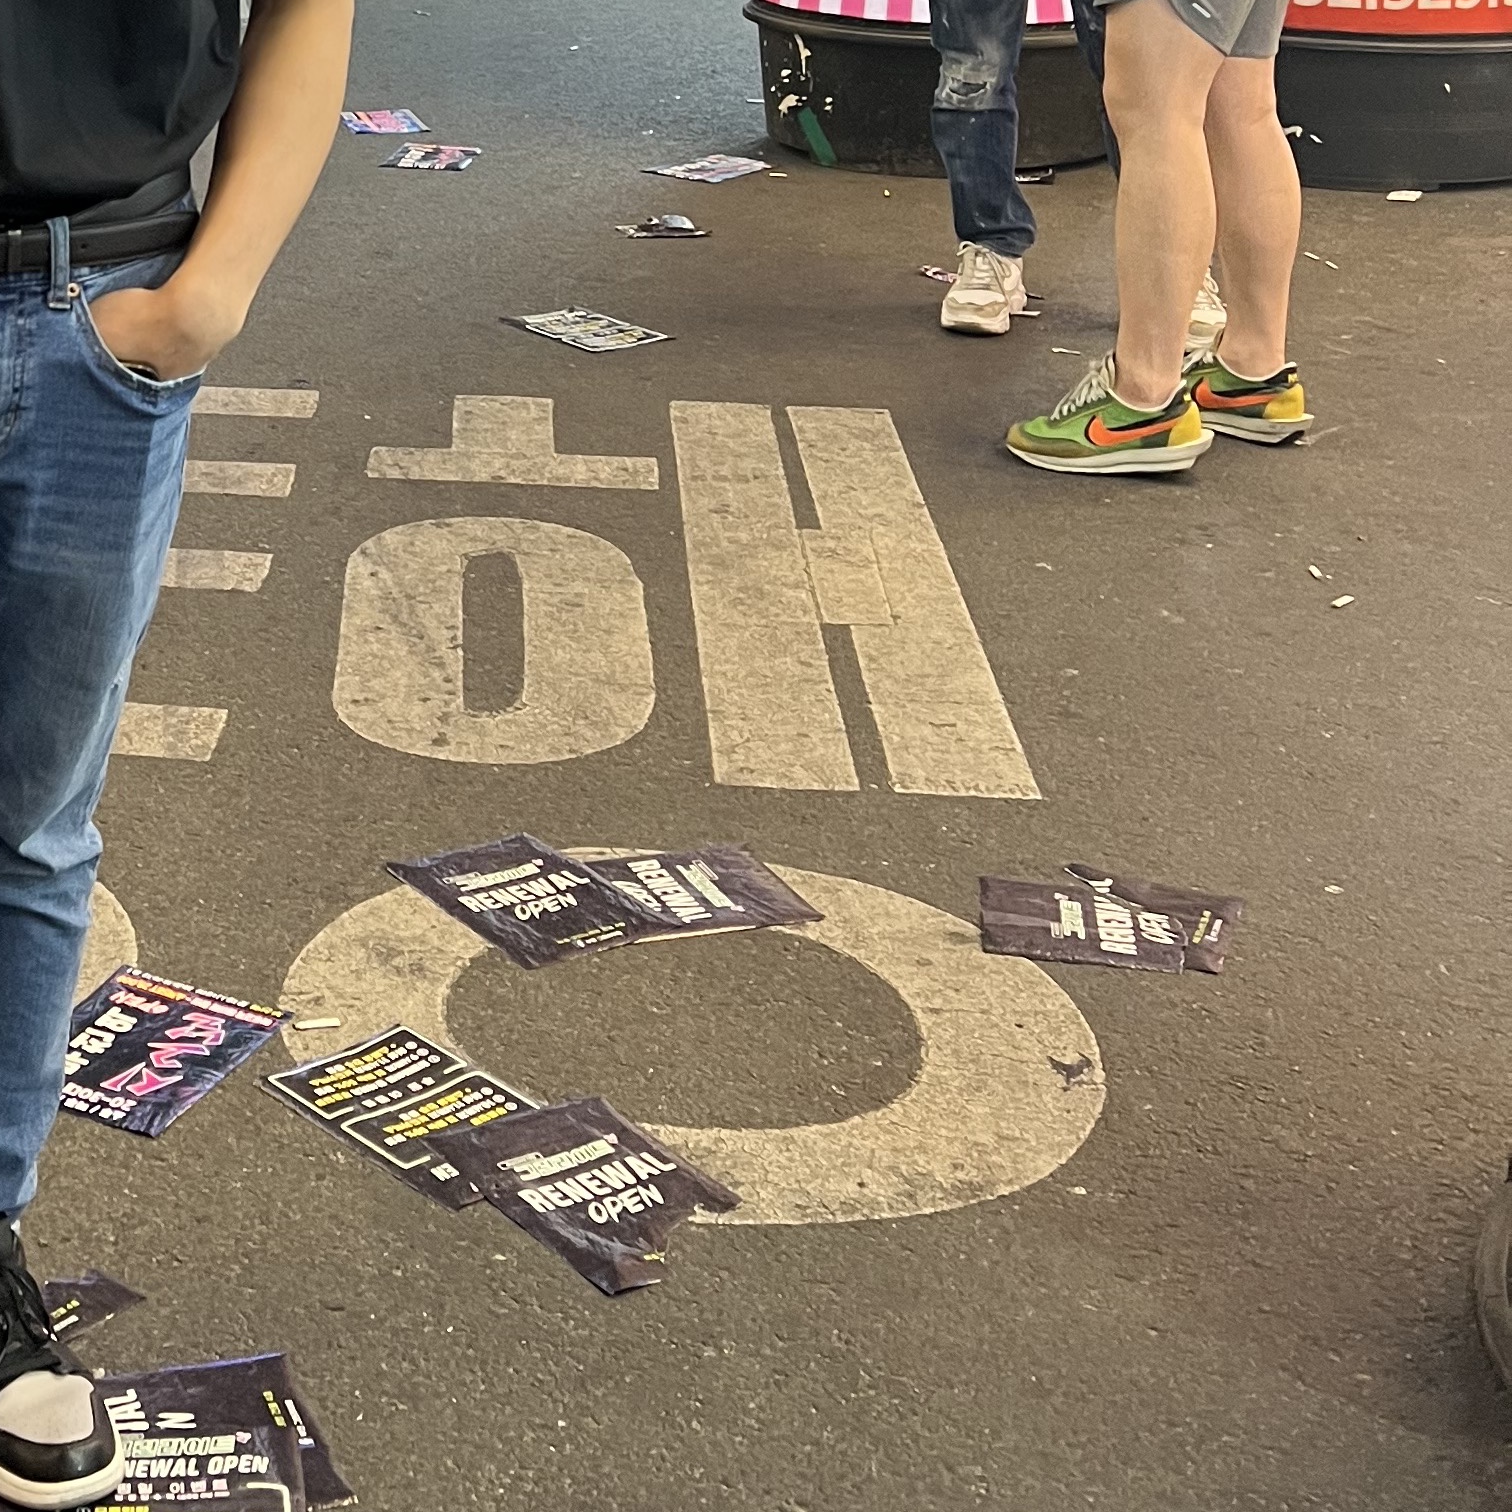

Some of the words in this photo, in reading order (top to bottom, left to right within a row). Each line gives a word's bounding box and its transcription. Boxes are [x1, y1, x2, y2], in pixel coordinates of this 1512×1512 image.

[457, 869, 592, 914] RENEWAL
[514, 892, 578, 921] OPEN
[626, 858, 714, 925] RENEWAL
[518, 1150, 678, 1214] RENEWAL
[587, 1183, 665, 1226] OPEN
[207, 1453, 271, 1476] OPEN
